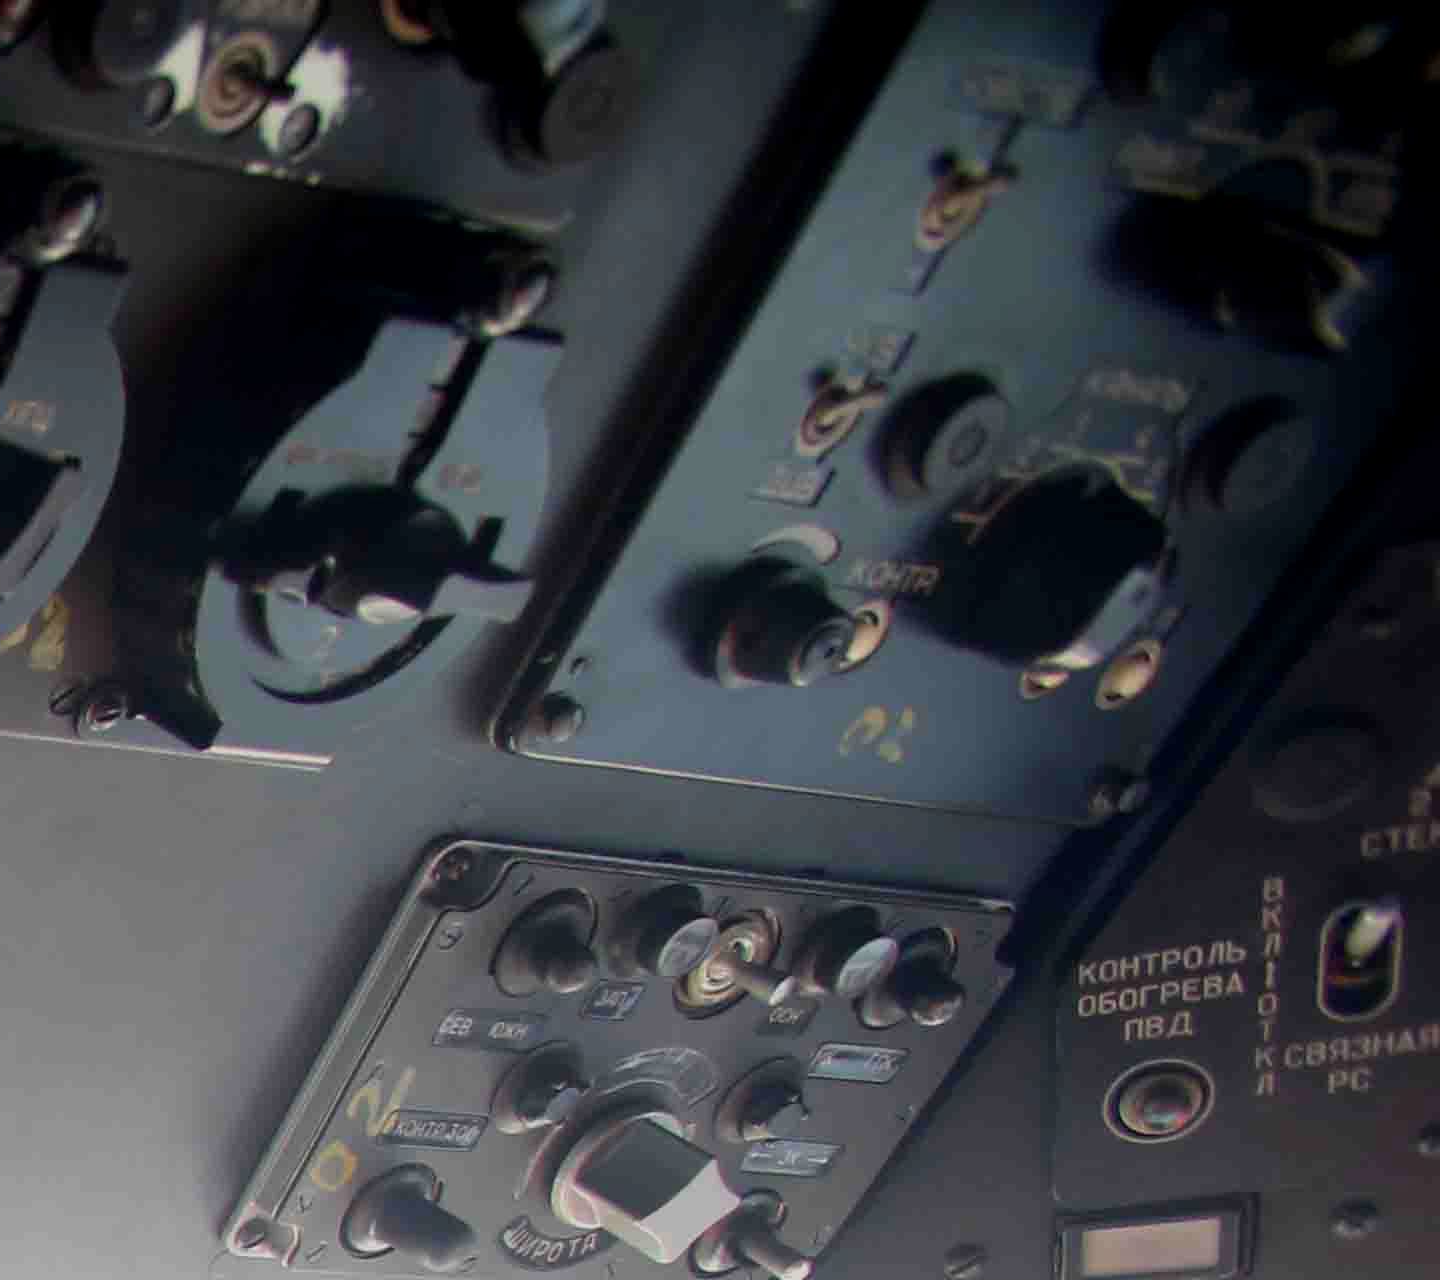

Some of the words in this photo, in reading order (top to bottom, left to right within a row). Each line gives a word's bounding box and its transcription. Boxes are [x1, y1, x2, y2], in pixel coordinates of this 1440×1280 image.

[1076, 940, 1247, 986] КОНТРОЛЬ
[1077, 971, 1245, 1018] ОБОГРЕВА
[1122, 1015, 1194, 1044] ПВД
[1328, 1067, 1374, 1095] РС
